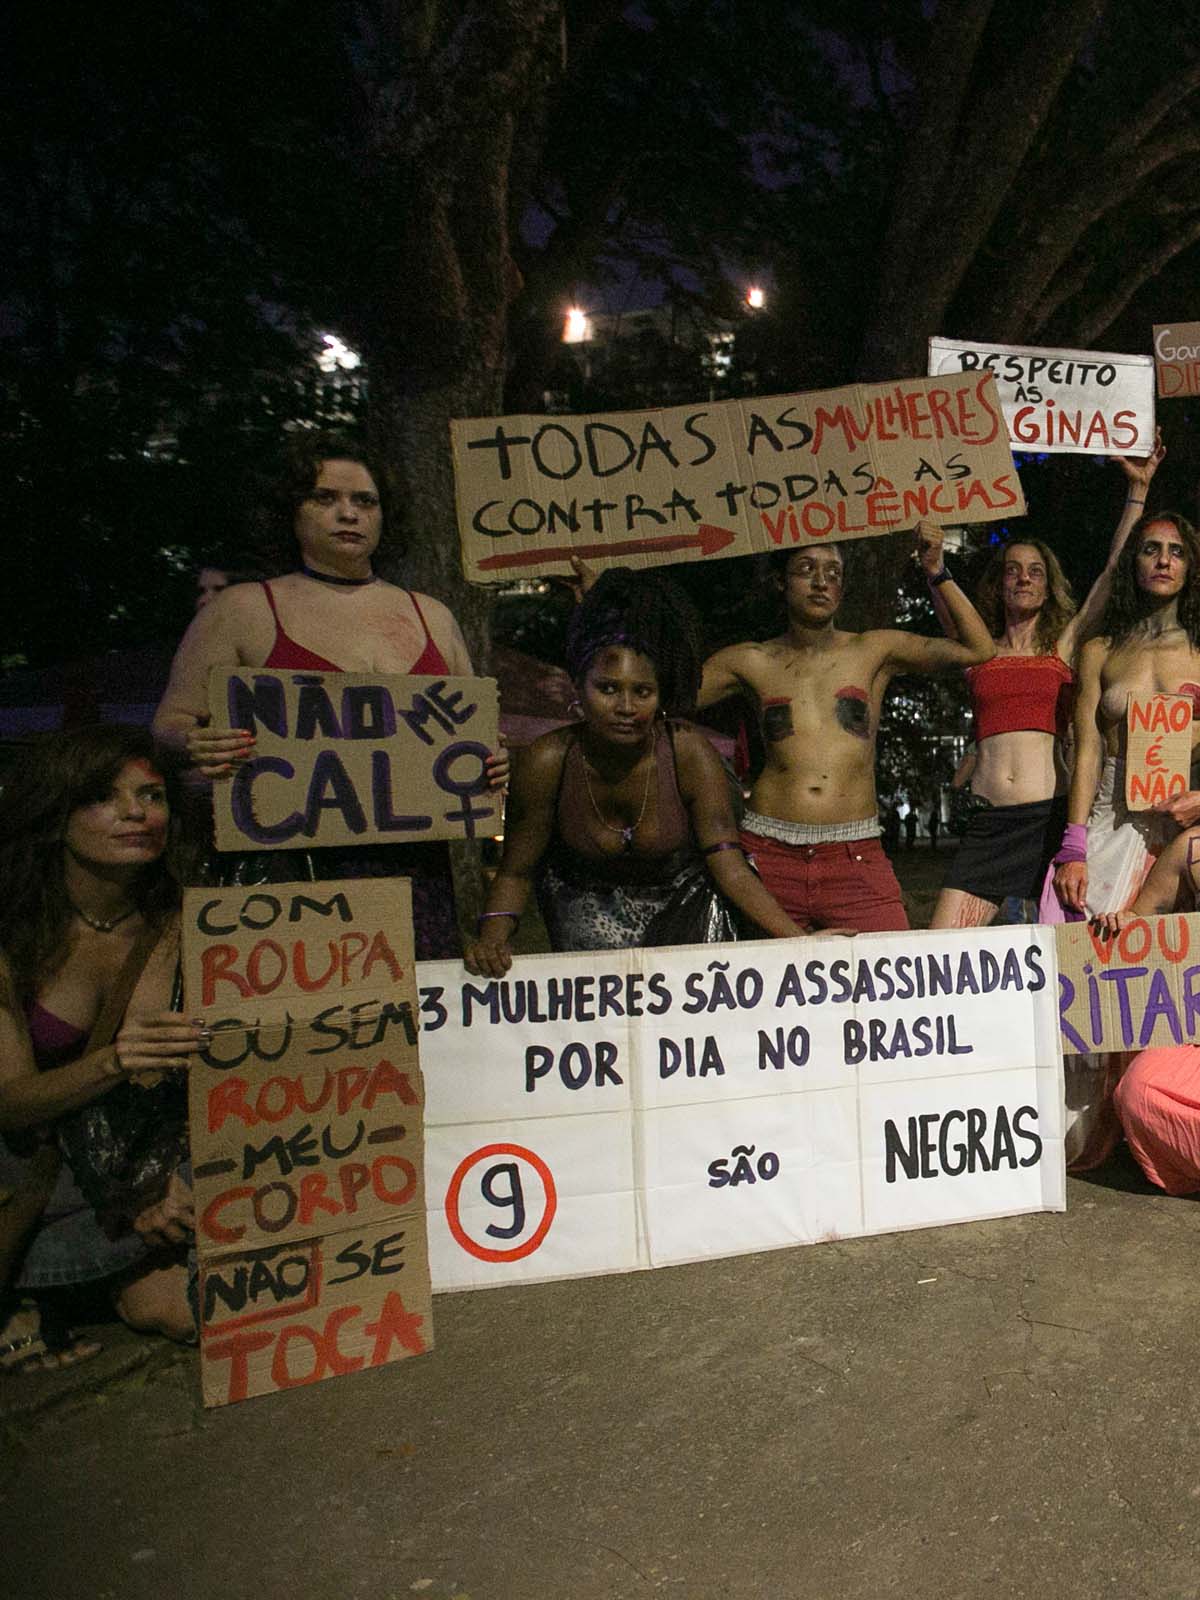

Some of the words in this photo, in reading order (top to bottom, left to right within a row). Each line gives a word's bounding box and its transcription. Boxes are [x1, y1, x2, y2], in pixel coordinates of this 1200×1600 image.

[467, 413, 716, 480] TODAS
[748, 407, 813, 455] AS
[811, 371, 998, 454] MULHERES
[1014, 382, 1043, 403] ÀS
[472, 488, 701, 537] CONTRA
[716, 462, 875, 516] TODAS
[914, 453, 971, 481] AS
[228, 674, 397, 740] NÃO
[397, 680, 478, 746] ME
[1130, 693, 1191, 734] NÃO
[1130, 768, 1186, 803] NÃO
[1146, 735, 1163, 767] É
[197, 892, 353, 936] COM
[201, 930, 404, 1007] ROUPA
[461, 973, 673, 1027] MULHERES
[681, 960, 764, 1014] SÃO
[775, 945, 1045, 1007] ASSASSINADAS
[200, 1011, 294, 1070] OU
[307, 1000, 420, 1055] SEM
[525, 1041, 623, 1092] POR
[659, 1035, 726, 1079] DIA
[758, 1025, 810, 1070] NO
[843, 1014, 974, 1065] BRASIL
[207, 1058, 420, 1134] ROUPA
[708, 1144, 780, 1188] SÃO
[884, 1105, 1043, 1184] NEGRAS
[201, 1155, 417, 1243] CORPO
[326, 1231, 406, 1286] SE
[205, 1291, 426, 1402] TOCA
